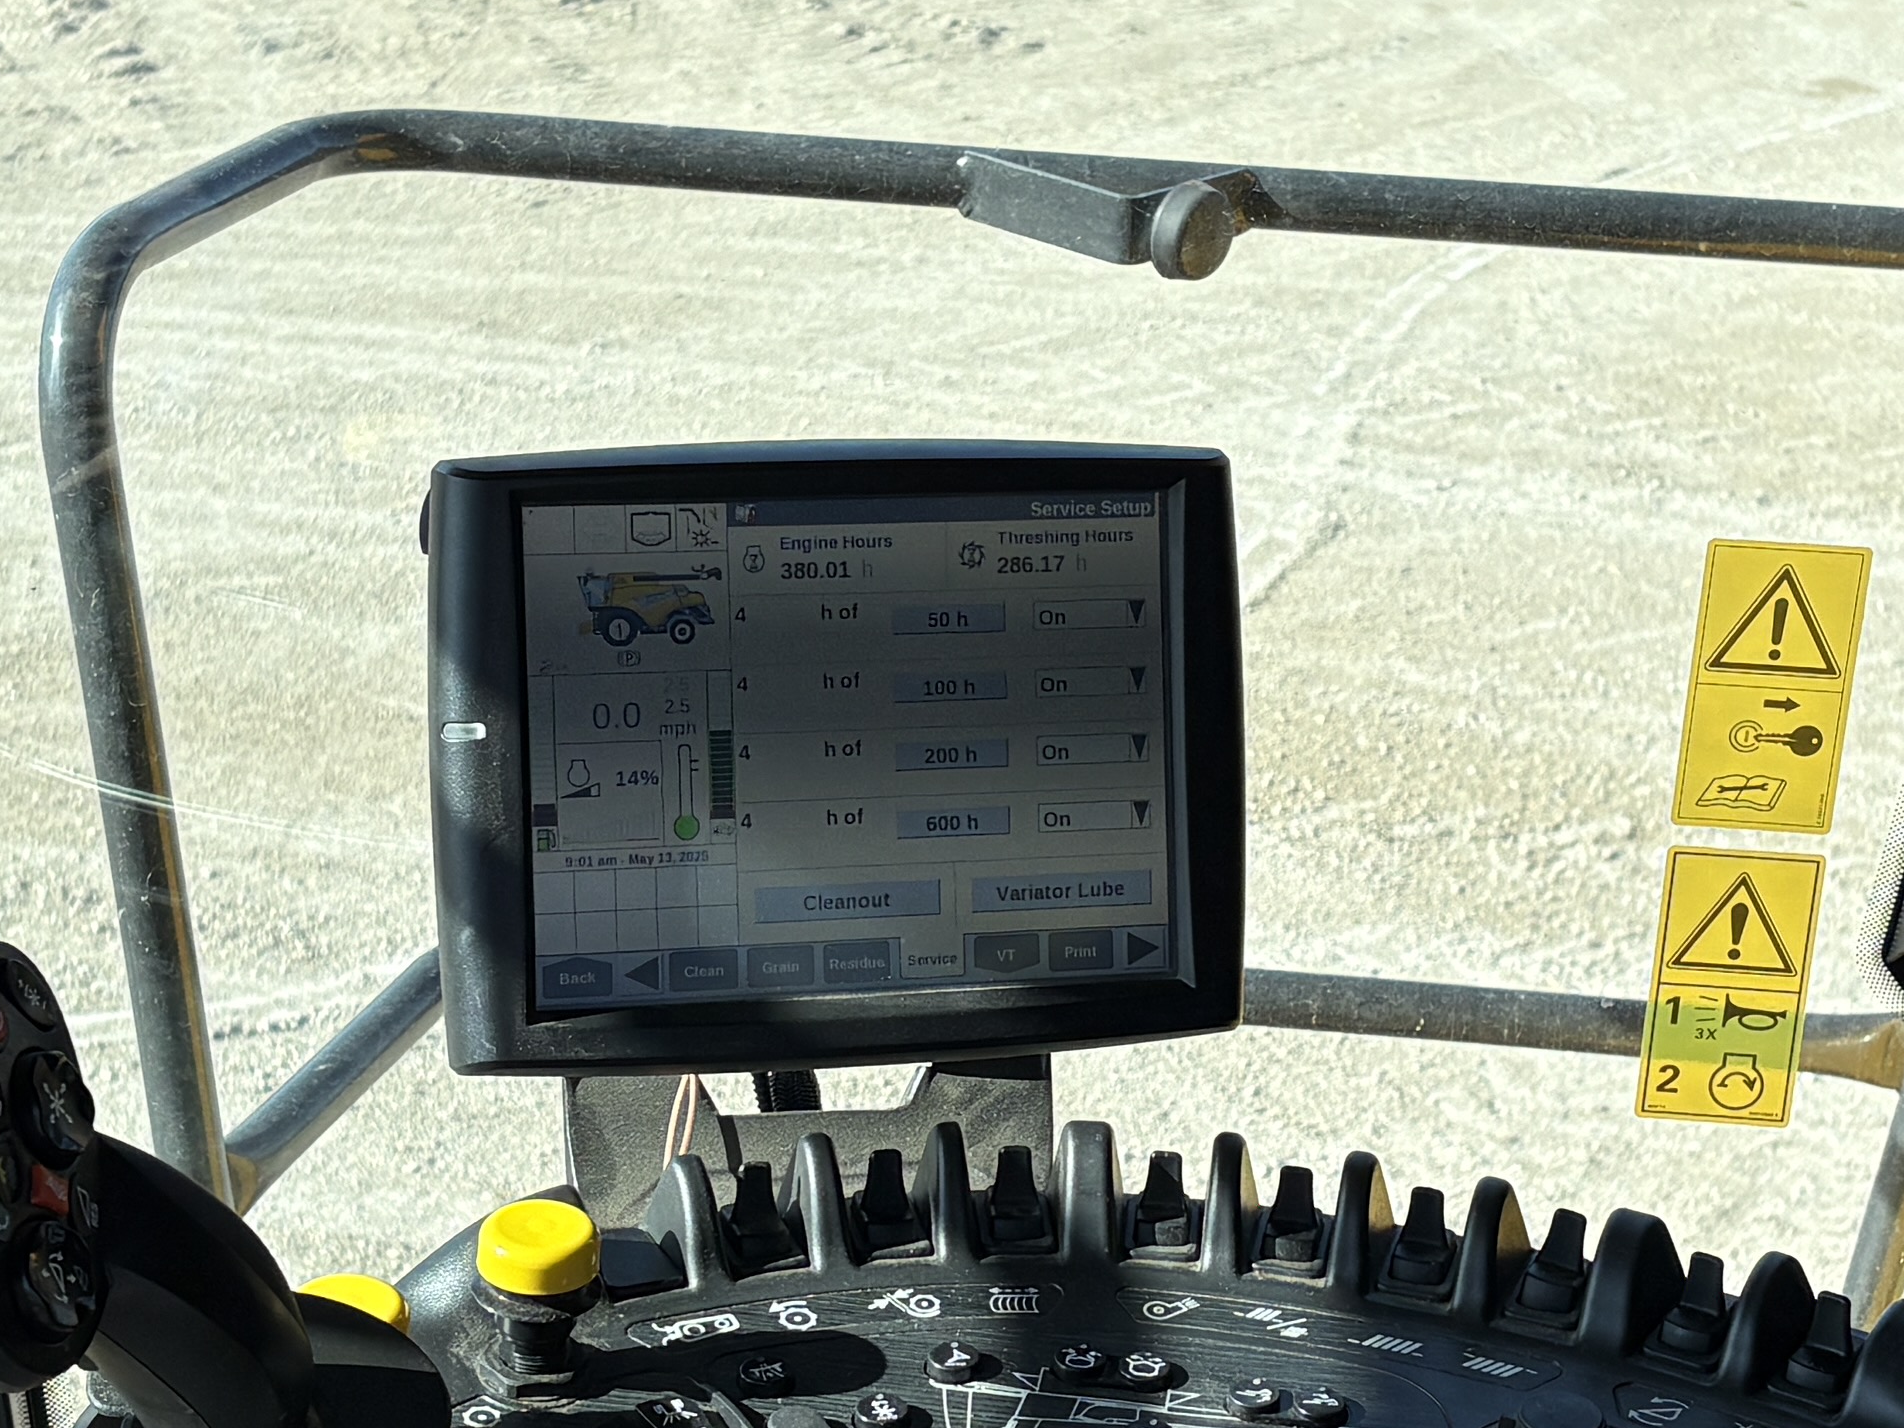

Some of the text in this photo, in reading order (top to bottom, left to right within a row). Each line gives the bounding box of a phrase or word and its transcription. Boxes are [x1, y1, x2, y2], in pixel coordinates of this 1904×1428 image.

[1031, 500, 1152, 519] Service Setup
[780, 534, 893, 554] Engine Hours
[999, 529, 1134, 548] Threshing Hours
[780, 560, 873, 580] 380.01 h
[997, 554, 1087, 573] 286.17 h
[735, 603, 859, 623] 4 h of
[928, 611, 968, 628] 50 h
[1040, 610, 1066, 626] On
[737, 672, 860, 691] 4 h of
[924, 679, 975, 696] 100 h
[1041, 677, 1067, 693] On
[593, 702, 640, 729] 0.0
[659, 722, 696, 739] mph
[739, 740, 862, 760] 4 h of
[925, 746, 977, 764] 200 h
[1043, 745, 1069, 760] On
[616, 770, 659, 787] 14%
[741, 808, 864, 829] 4 h of
[926, 814, 979, 831] 600 h
[1044, 812, 1070, 828] On
[598, 857, 617, 866] am
[629, 853, 655, 868] May
[996, 881, 1125, 902] Variator Lube
[803, 892, 890, 911] Cleanout
[907, 953, 958, 966] Service
[997, 949, 1016, 962] VT
[1064, 945, 1097, 958] Print
[684, 964, 724, 979] Clean
[762, 961, 800, 975] Grain
[829, 956, 885, 970] Residue
[559, 972, 596, 986] Back
[1665, 996, 1681, 1025] 1
[1694, 1028, 1717, 1040] 3X
[1656, 1065, 1680, 1093] 2
